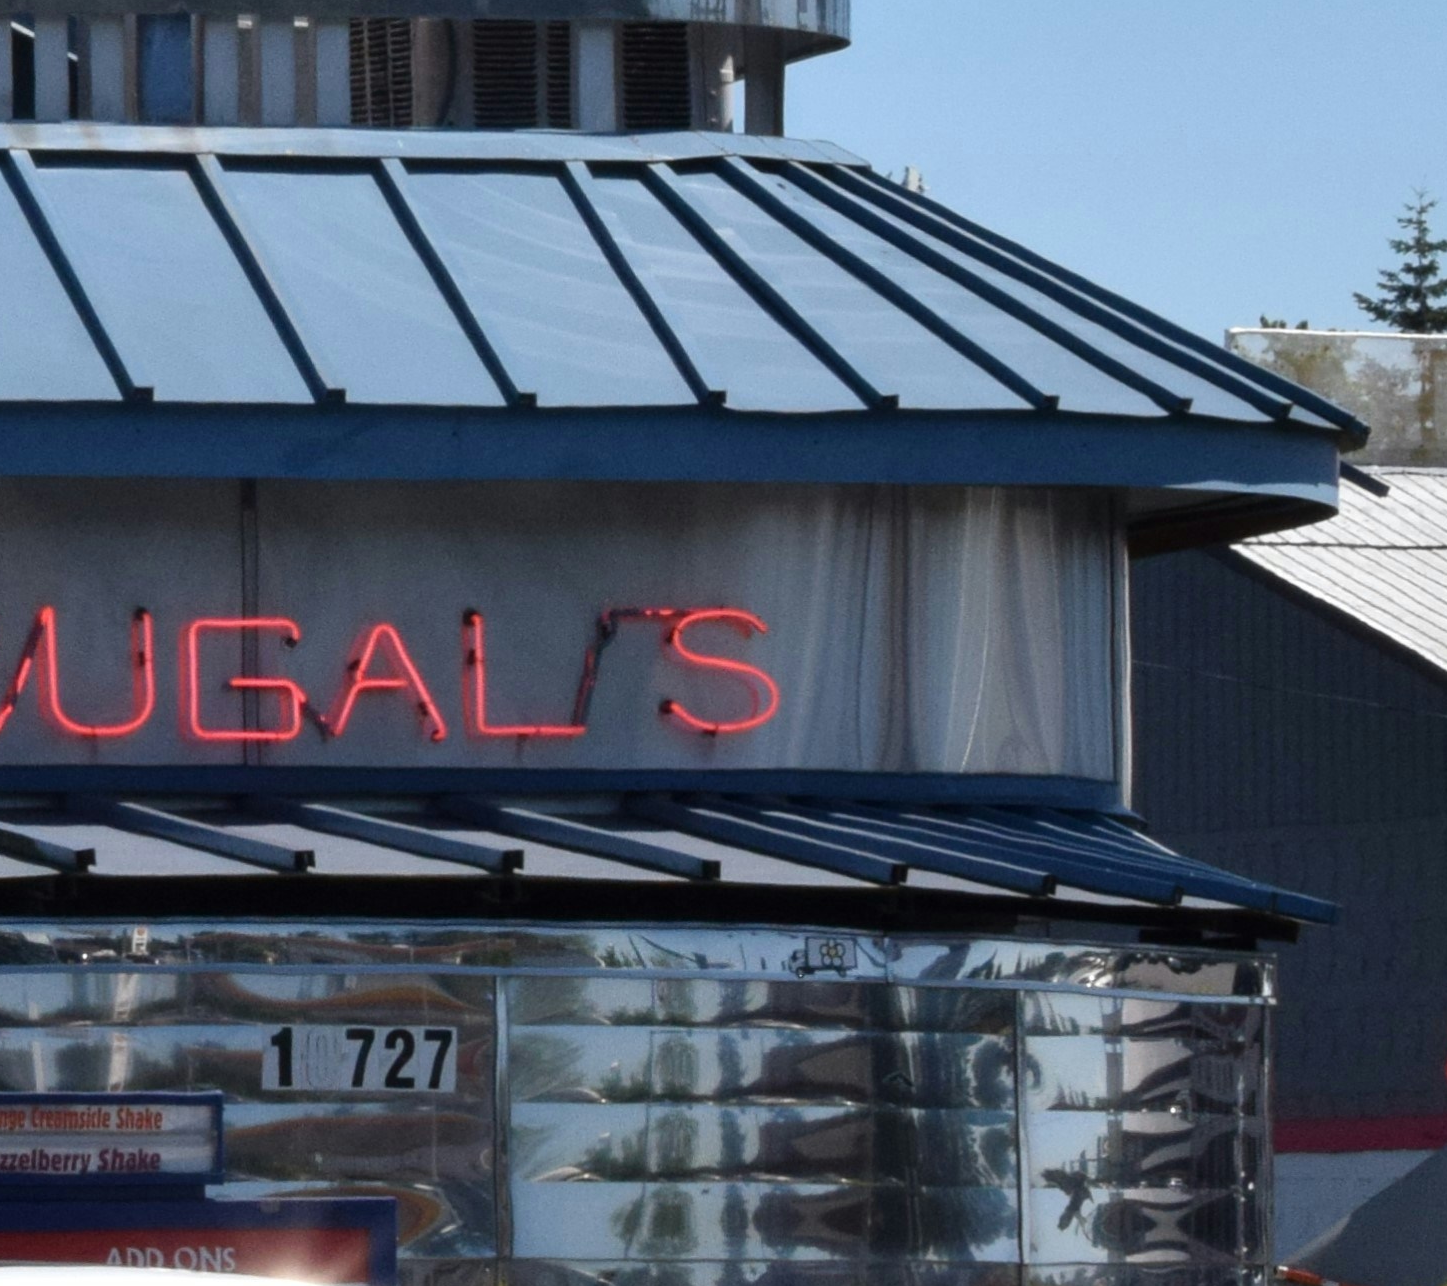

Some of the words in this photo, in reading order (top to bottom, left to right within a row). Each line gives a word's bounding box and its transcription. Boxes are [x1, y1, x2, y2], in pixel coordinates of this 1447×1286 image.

[115, 1106, 163, 1131] Shake
[97, 1148, 161, 1171] Shake
[106, 1246, 165, 1269] ADD
[172, 1245, 237, 1273] ONS
